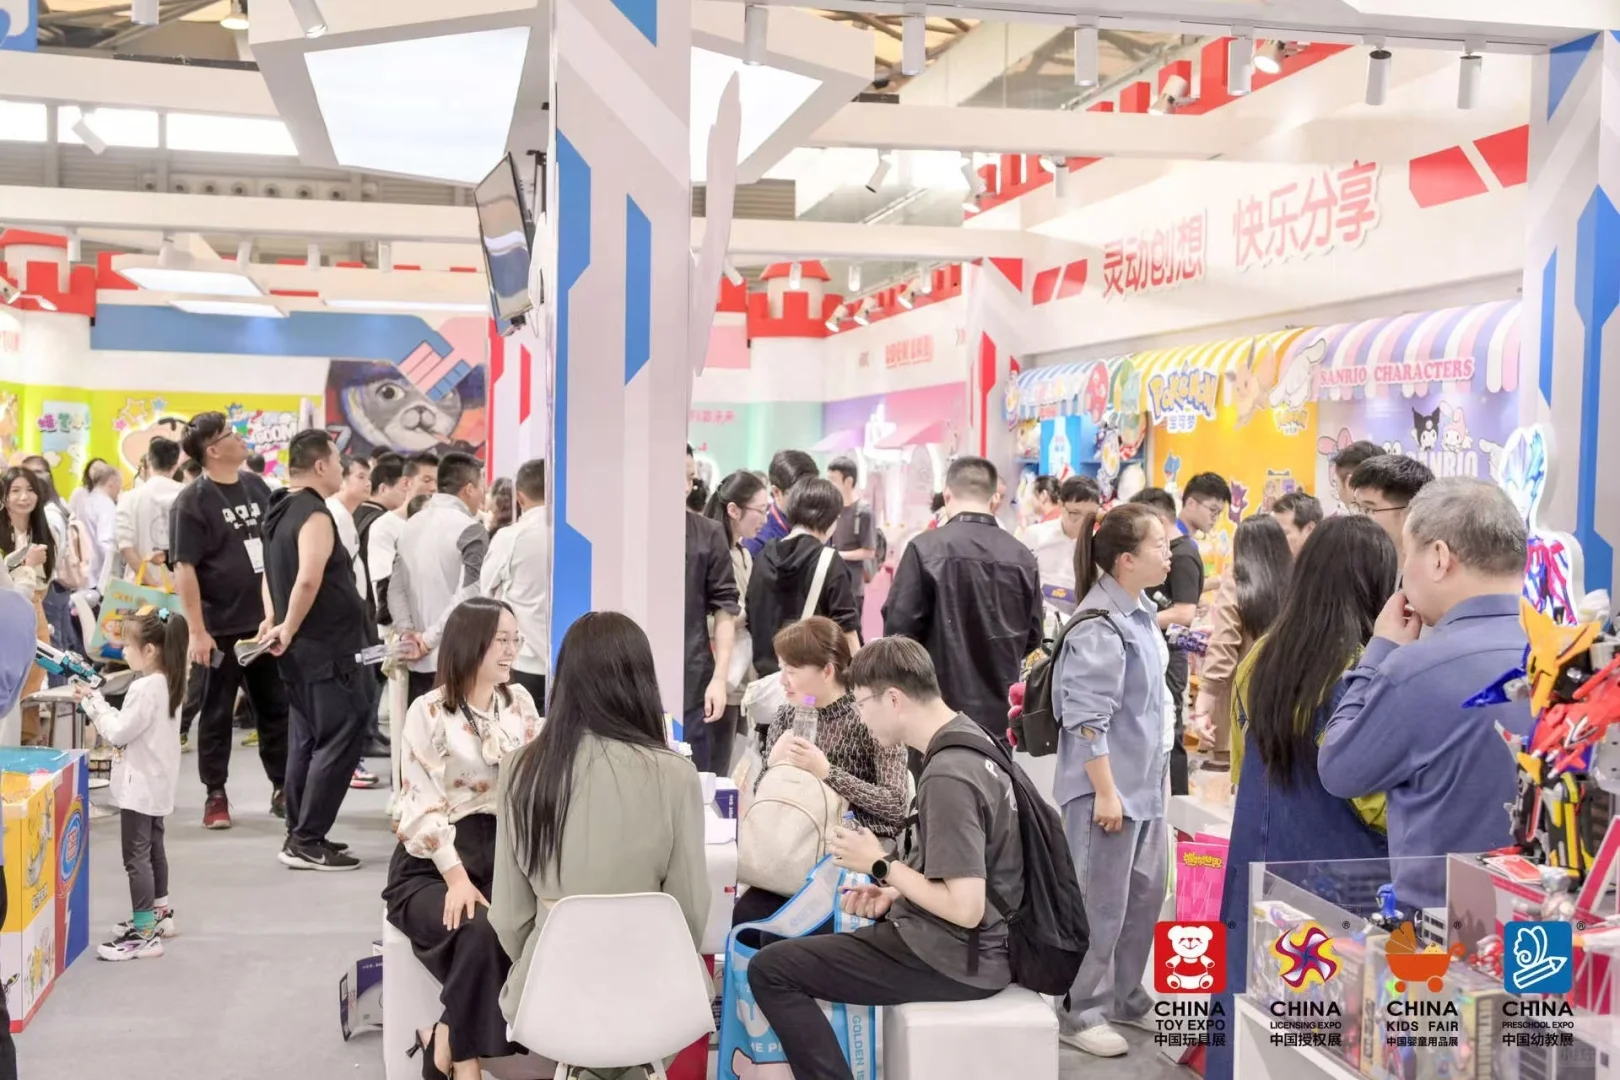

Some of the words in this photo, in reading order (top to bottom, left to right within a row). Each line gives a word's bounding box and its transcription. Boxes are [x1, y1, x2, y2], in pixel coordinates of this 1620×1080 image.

[1102, 213, 1206, 298] 灵动创想
[1233, 159, 1377, 267] 快乐分享
[1320, 367, 1367, 385] SANRIO
[1374, 359, 1474, 382] CHARACTERS
[1405, 450, 1478, 477] NRIO
[852, 1014, 864, 1066] GOLDEN
